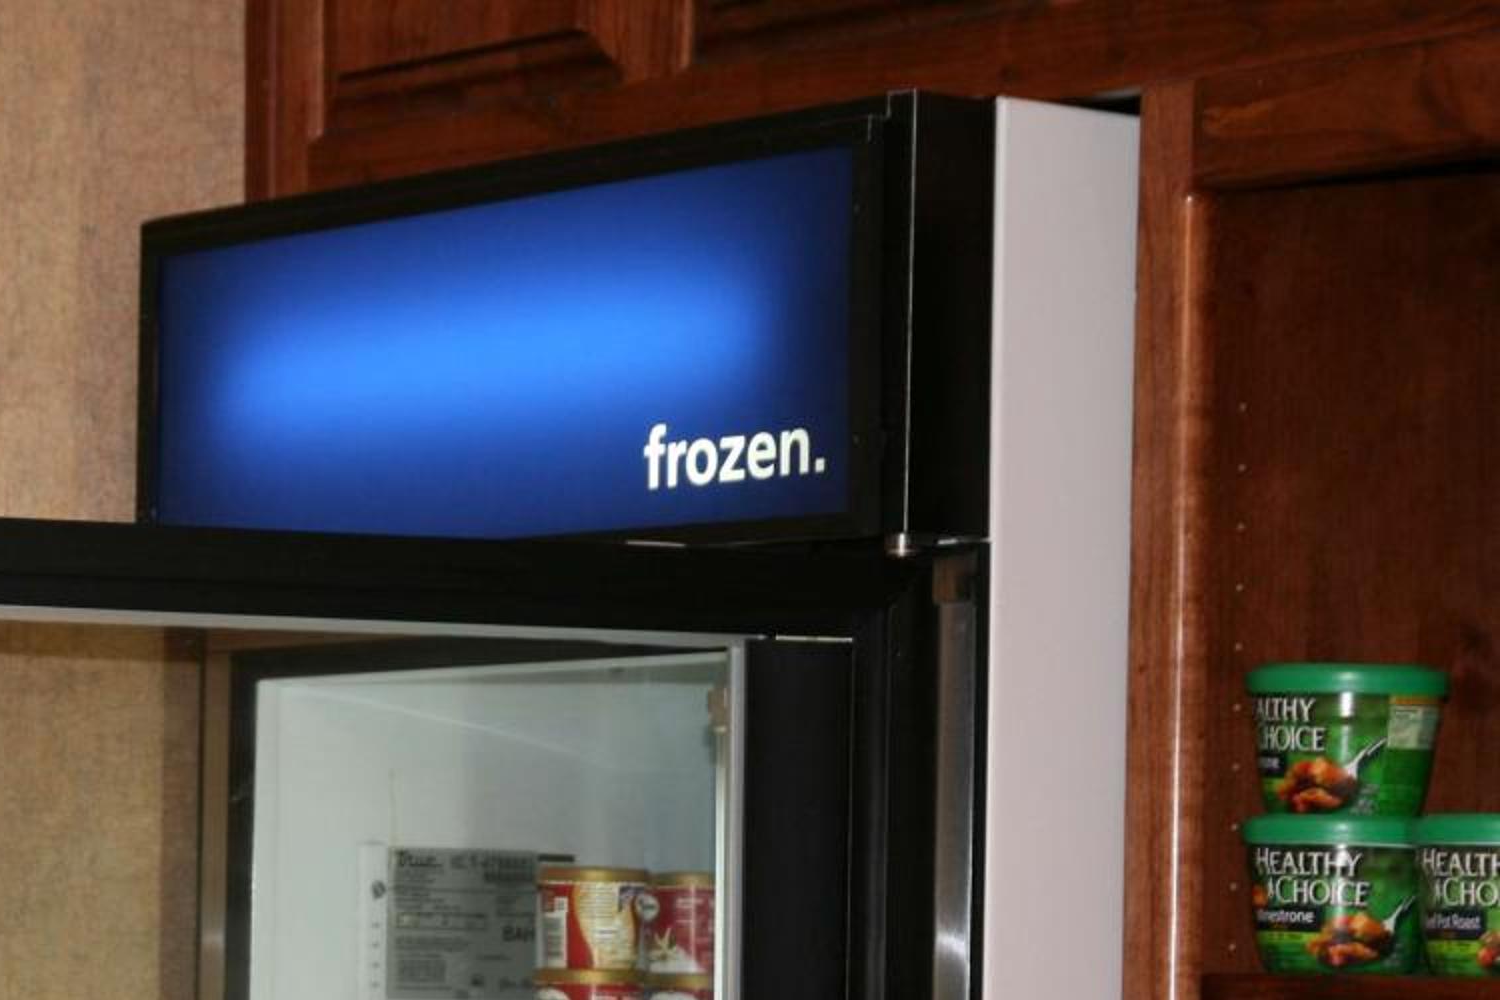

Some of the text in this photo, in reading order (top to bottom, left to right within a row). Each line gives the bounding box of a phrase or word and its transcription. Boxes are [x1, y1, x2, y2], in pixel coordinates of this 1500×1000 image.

[643, 422, 826, 491] frozen.
[1256, 847, 1363, 877] HEALTHY
[1274, 875, 1371, 907] CHOICE
[1442, 877, 1500, 908] CHO
